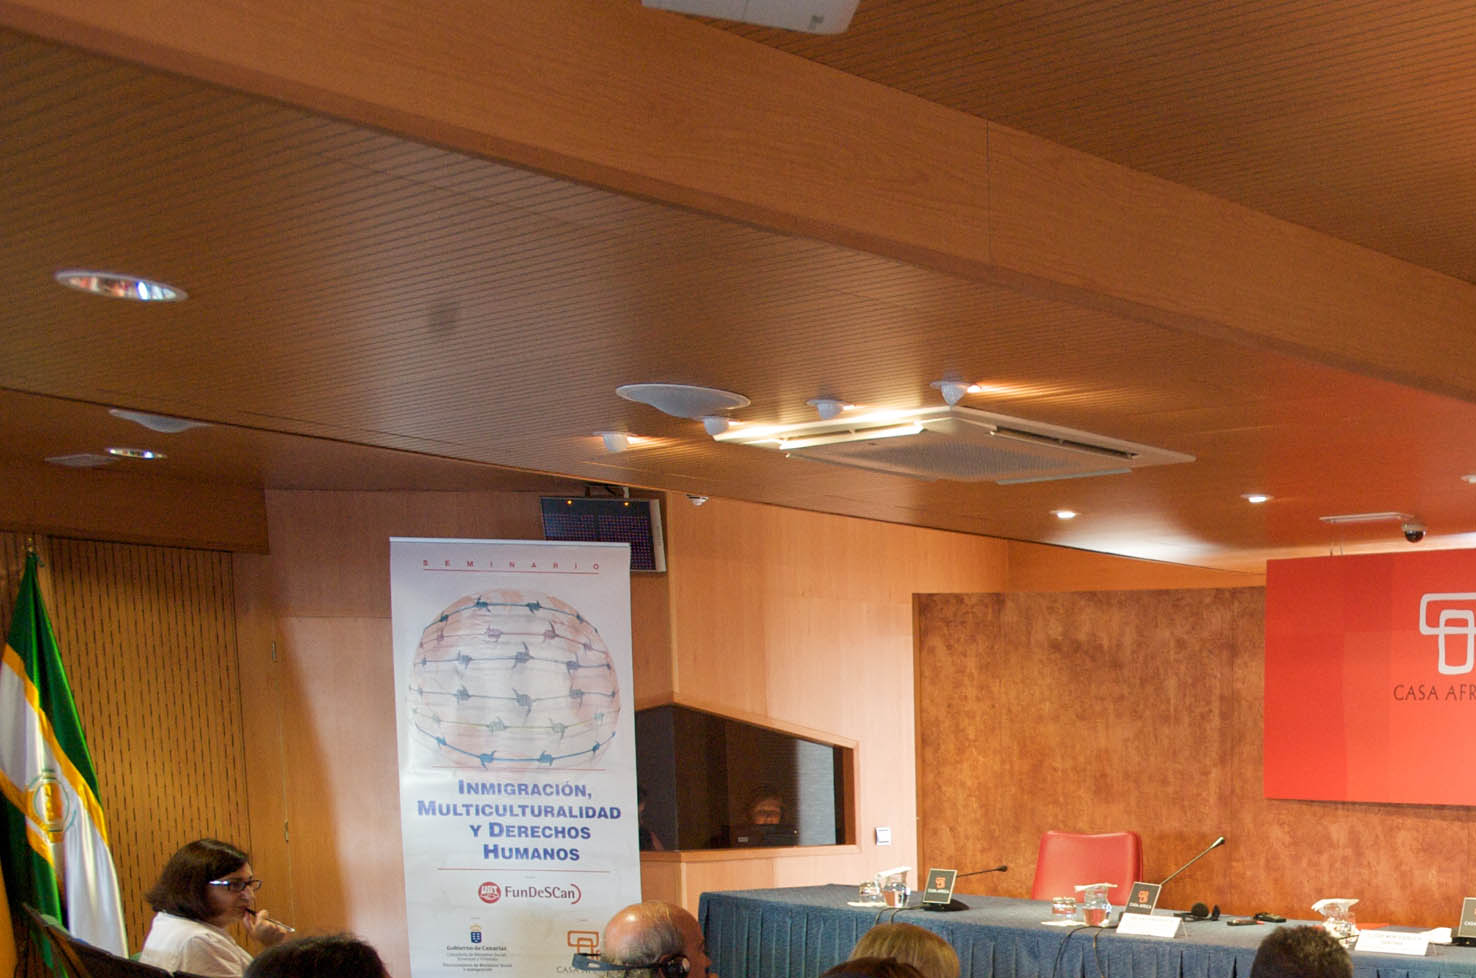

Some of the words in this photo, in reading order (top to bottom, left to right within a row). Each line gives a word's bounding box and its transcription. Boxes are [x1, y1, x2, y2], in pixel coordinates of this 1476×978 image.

[423, 559, 599, 570] SEMINARIO
[1393, 683, 1439, 701] CASA
[458, 779, 592, 799] INMIGRACIÓN,
[417, 800, 621, 819] MULTICULTURALIDAD
[489, 822, 591, 839] DERECHOS
[483, 844, 580, 861] HUMANOS
